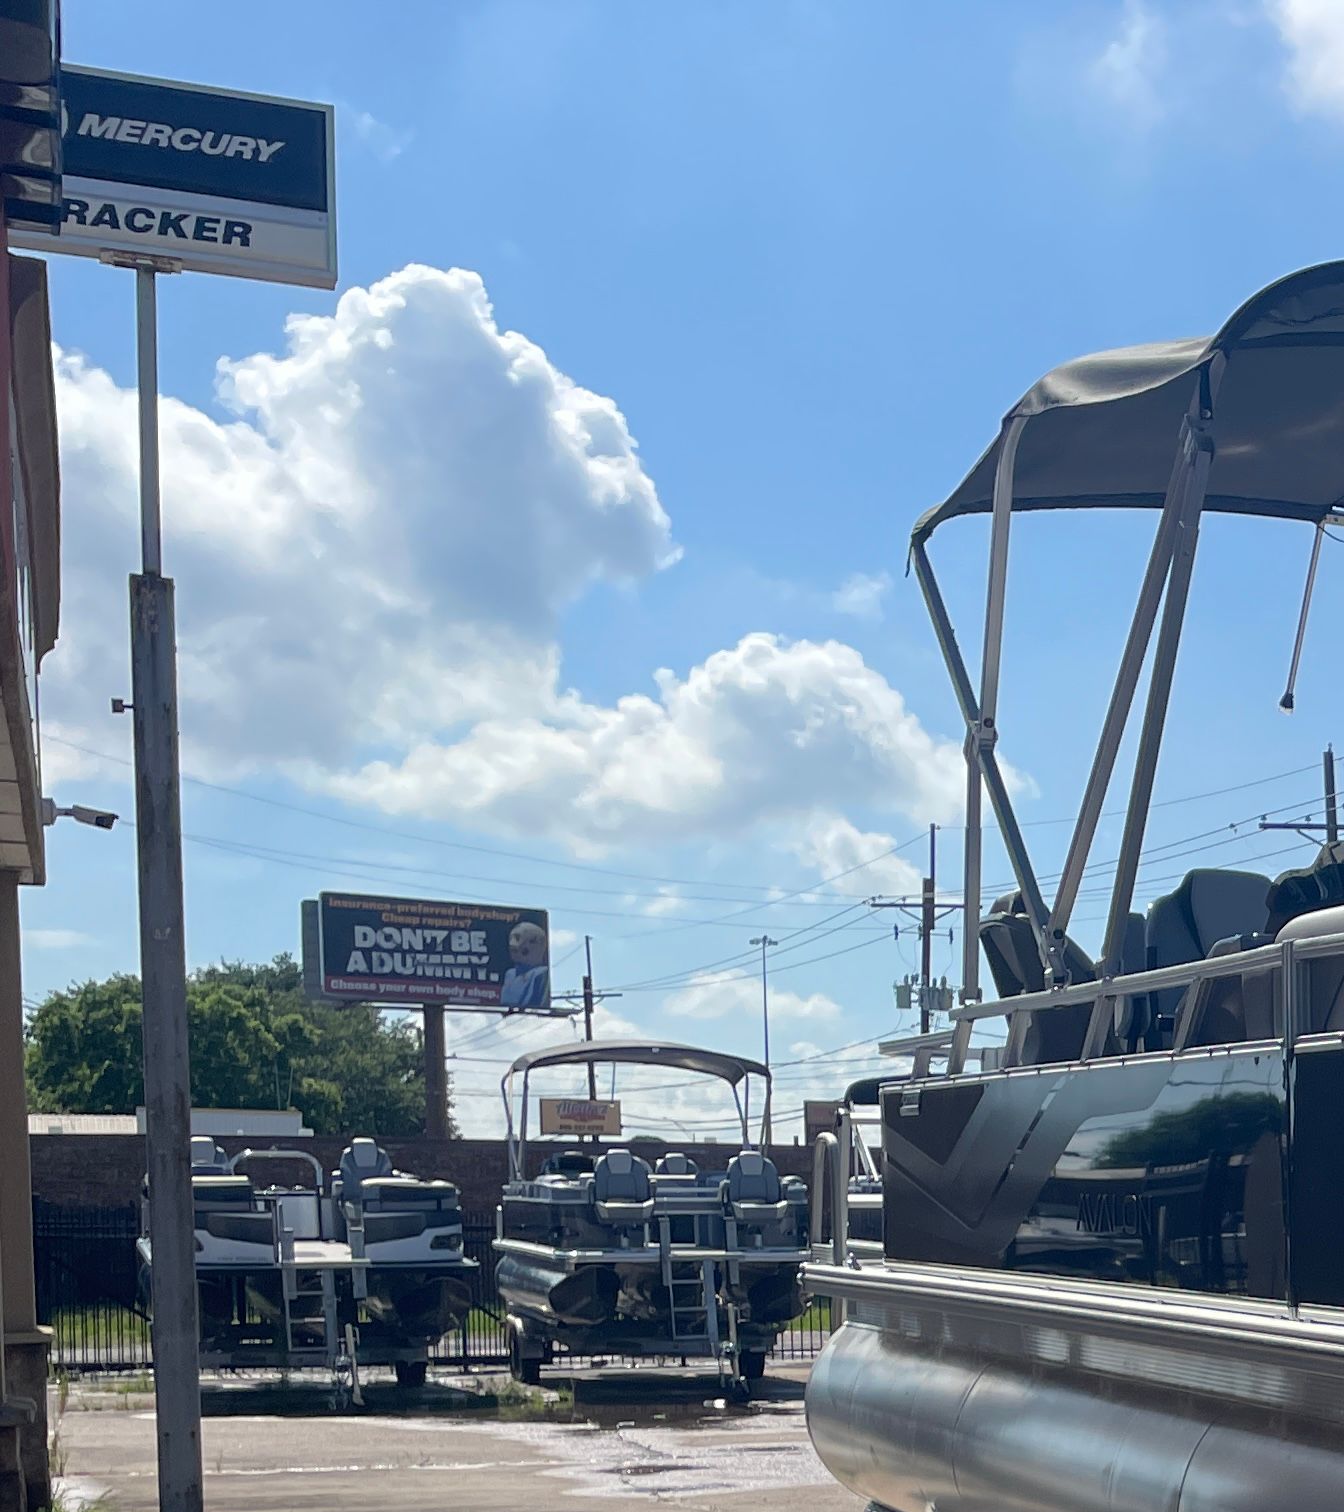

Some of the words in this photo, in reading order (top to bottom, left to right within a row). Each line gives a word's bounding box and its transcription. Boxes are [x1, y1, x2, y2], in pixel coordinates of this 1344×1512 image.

[77, 114, 286, 163] MERCURY
[61, 198, 252, 247] RACKER
[354, 925, 449, 951] DON'T
[451, 930, 488, 953] BE
[346, 951, 370, 974] A
[330, 979, 377, 993] Choose
[379, 982, 406, 995] your
[409, 986, 434, 994] own
[436, 985, 465, 998] body
[467, 988, 500, 1000] shop.
